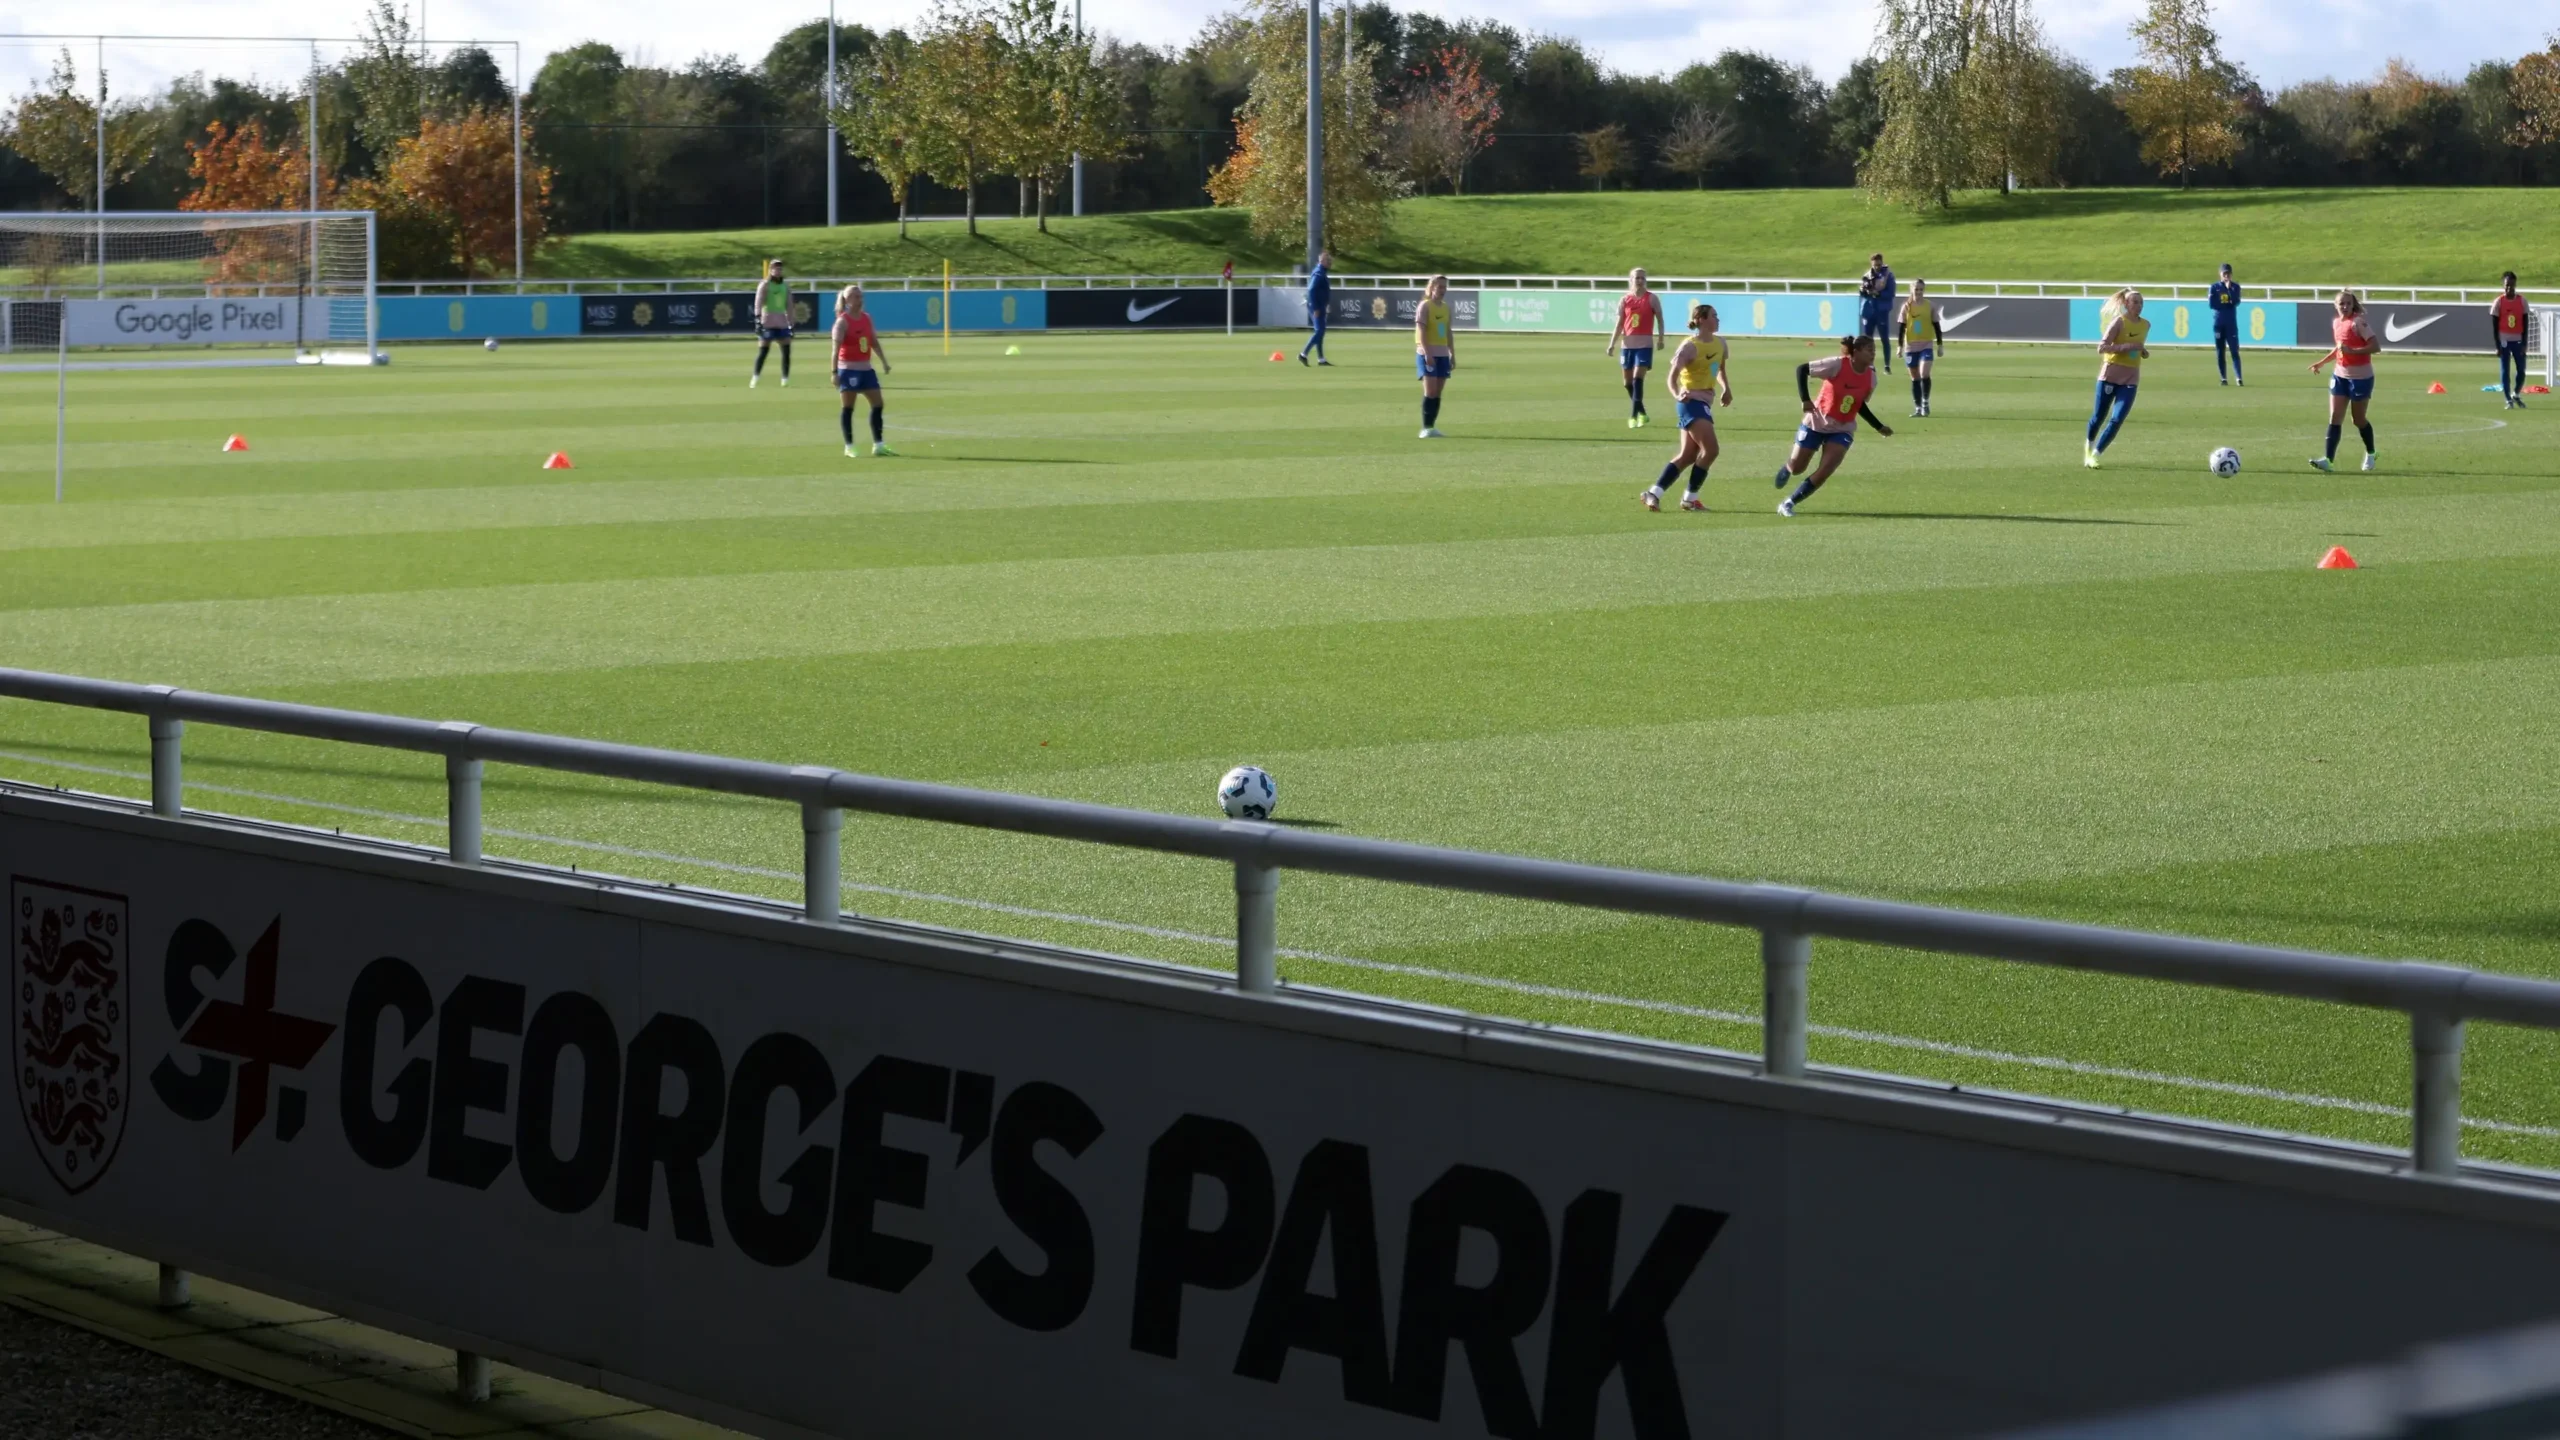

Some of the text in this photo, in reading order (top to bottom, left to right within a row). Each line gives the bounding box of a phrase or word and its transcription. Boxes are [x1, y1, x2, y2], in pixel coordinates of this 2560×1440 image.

[587, 304, 616, 319] M&S
[668, 304, 697, 318] M&S
[1340, 299, 1361, 312] M&S
[1397, 300, 1418, 313] M&S
[1455, 300, 1476, 314] M&S
[115, 302, 283, 340] Google Pixel
[340, 956, 1105, 1332] GEORGE'S
[1130, 1113, 1730, 1440] PARK
